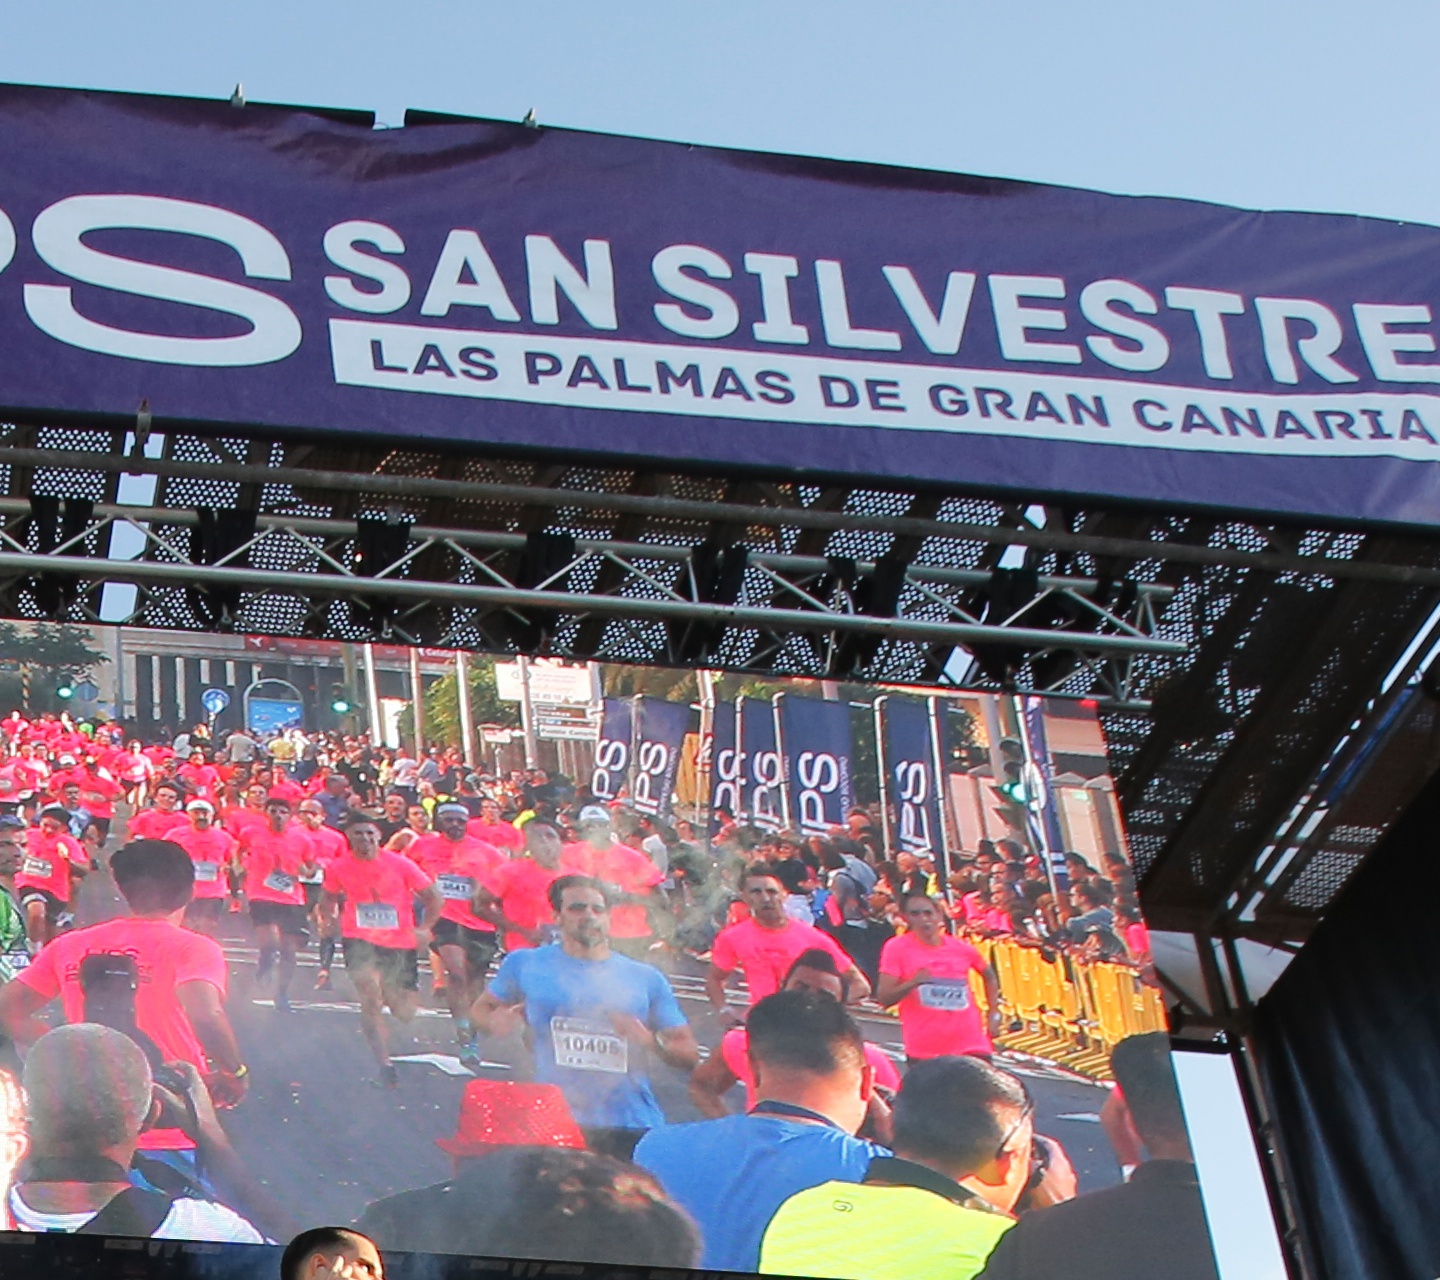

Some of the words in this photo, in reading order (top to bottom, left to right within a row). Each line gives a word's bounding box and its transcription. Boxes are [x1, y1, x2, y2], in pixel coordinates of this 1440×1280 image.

[322, 219, 617, 329] SAN
[368, 336, 500, 382] LAS
[524, 349, 793, 406] PALMAS
[820, 373, 907, 412] DE
[930, 382, 1109, 428] GRAN
[1131, 397, 1437, 447] CANARIA
